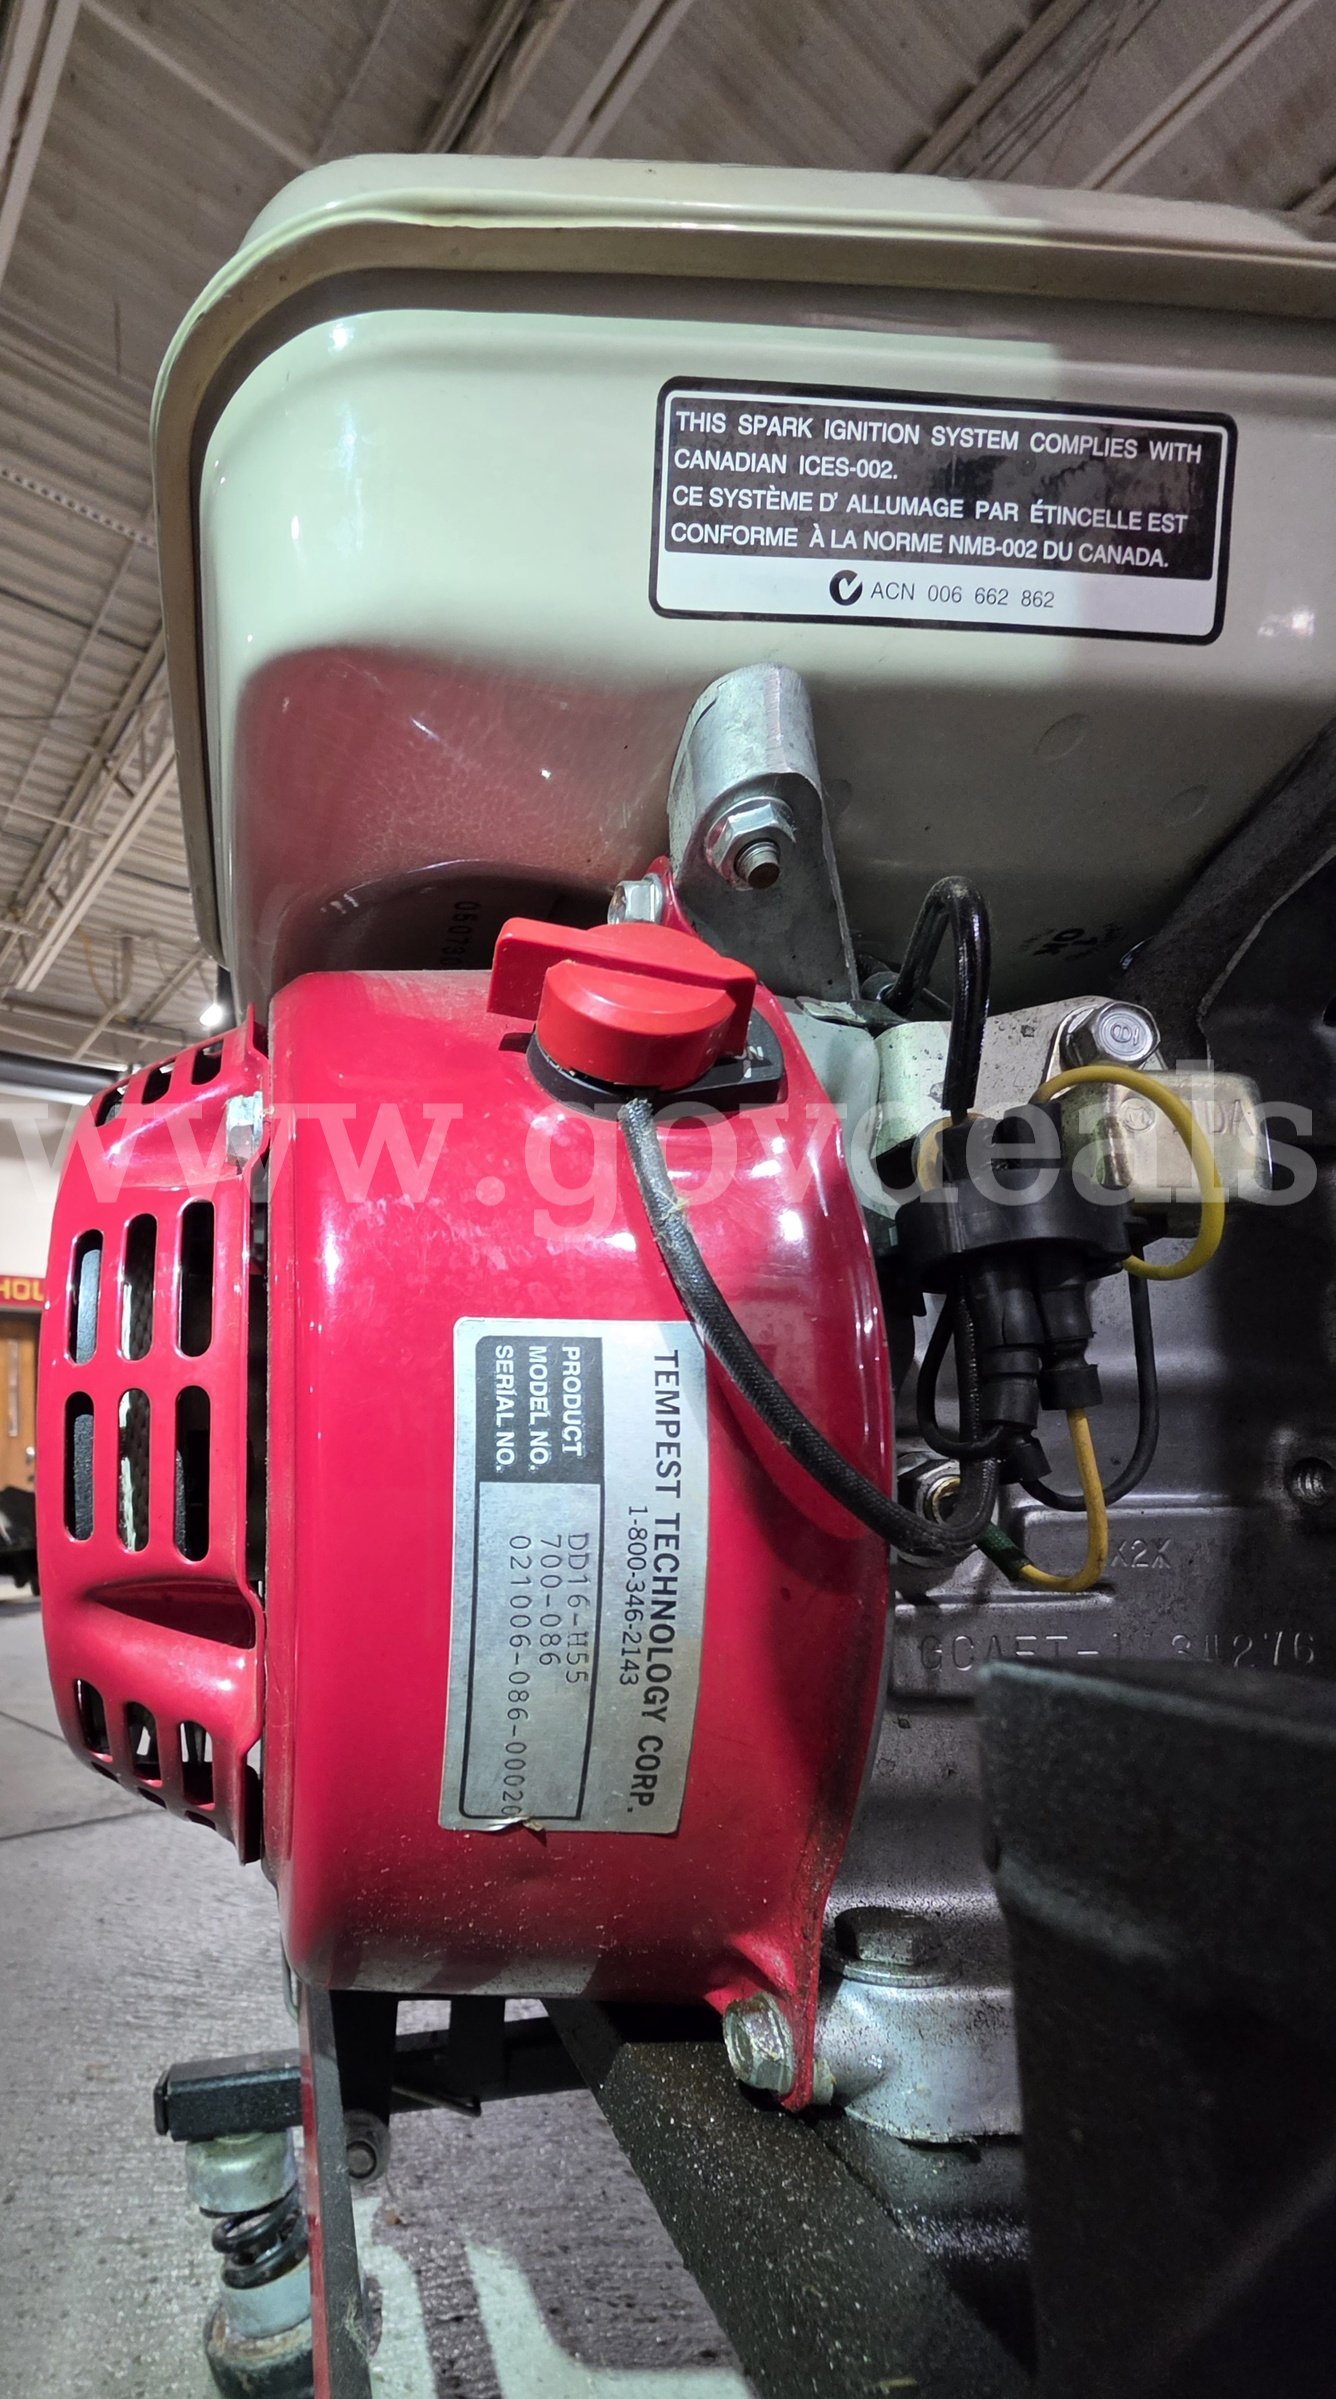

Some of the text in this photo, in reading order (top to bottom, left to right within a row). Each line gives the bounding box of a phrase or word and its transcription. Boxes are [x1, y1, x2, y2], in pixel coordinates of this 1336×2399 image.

[674, 448, 898, 480] CANADIAN ICES-002.
[676, 411, 1202, 464] THIS SPARK IGNITION SYSTEM COMPLIES WITH
[671, 522, 1169, 567] CONFORME À LA NORME NMB-002 DU CANADA.
[672, 485, 703, 507] CE
[708, 485, 813, 511] SYSTÈME
[846, 494, 964, 518] ALLUMAGE
[975, 501, 1018, 521] PAR
[1030, 499, 1142, 531] ÉTINCELLE
[1147, 513, 1188, 534] EST
[870, 582, 1055, 608] ACN 006 662 862
[495, 1345, 515, 1472] SERIAL NO.
[528, 1346, 551, 1472] MODEL NO.
[560, 1346, 584, 1457] PRODUCT
[538, 1534, 563, 1666] 700-086
[565, 1532, 591, 1684] DD16-H55
[619, 1505, 649, 1686] 1-800-346-2143
[625, 1350, 683, 1813] TEMPEST TECHNOLOGY CORP.
